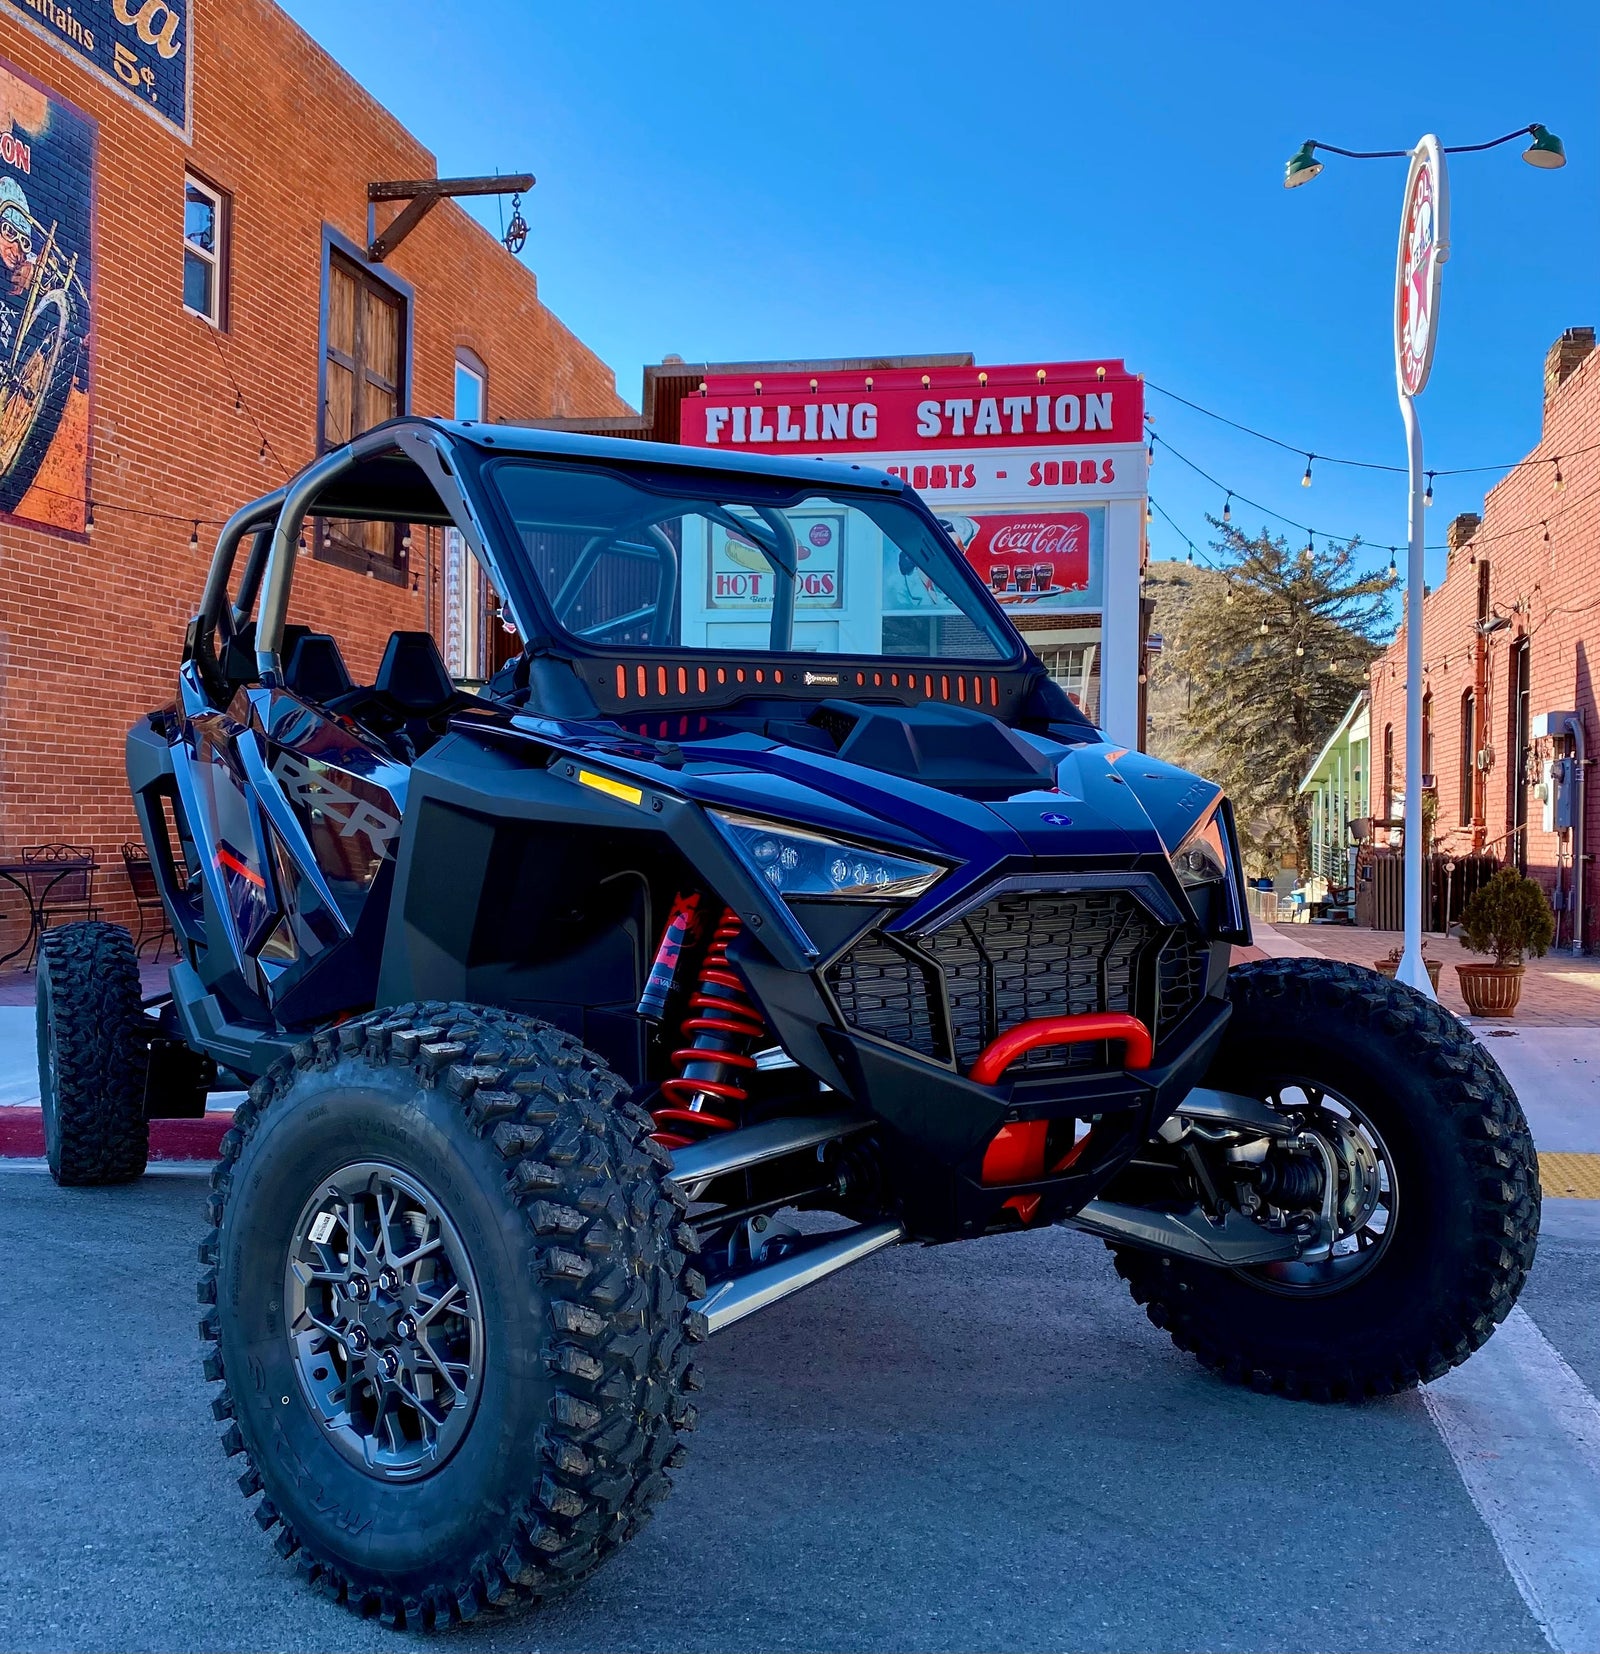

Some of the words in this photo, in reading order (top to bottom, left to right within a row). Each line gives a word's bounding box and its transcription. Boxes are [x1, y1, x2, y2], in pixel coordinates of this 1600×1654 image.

[0, 132, 30, 174] ON
[705, 402, 878, 443] FILLING
[916, 392, 1113, 438] STATION
[1027, 458, 1115, 487] SODAS
[989, 524, 1083, 555] Coca-Cola
[717, 574, 762, 595] HOT
[272, 751, 400, 862] RZR
